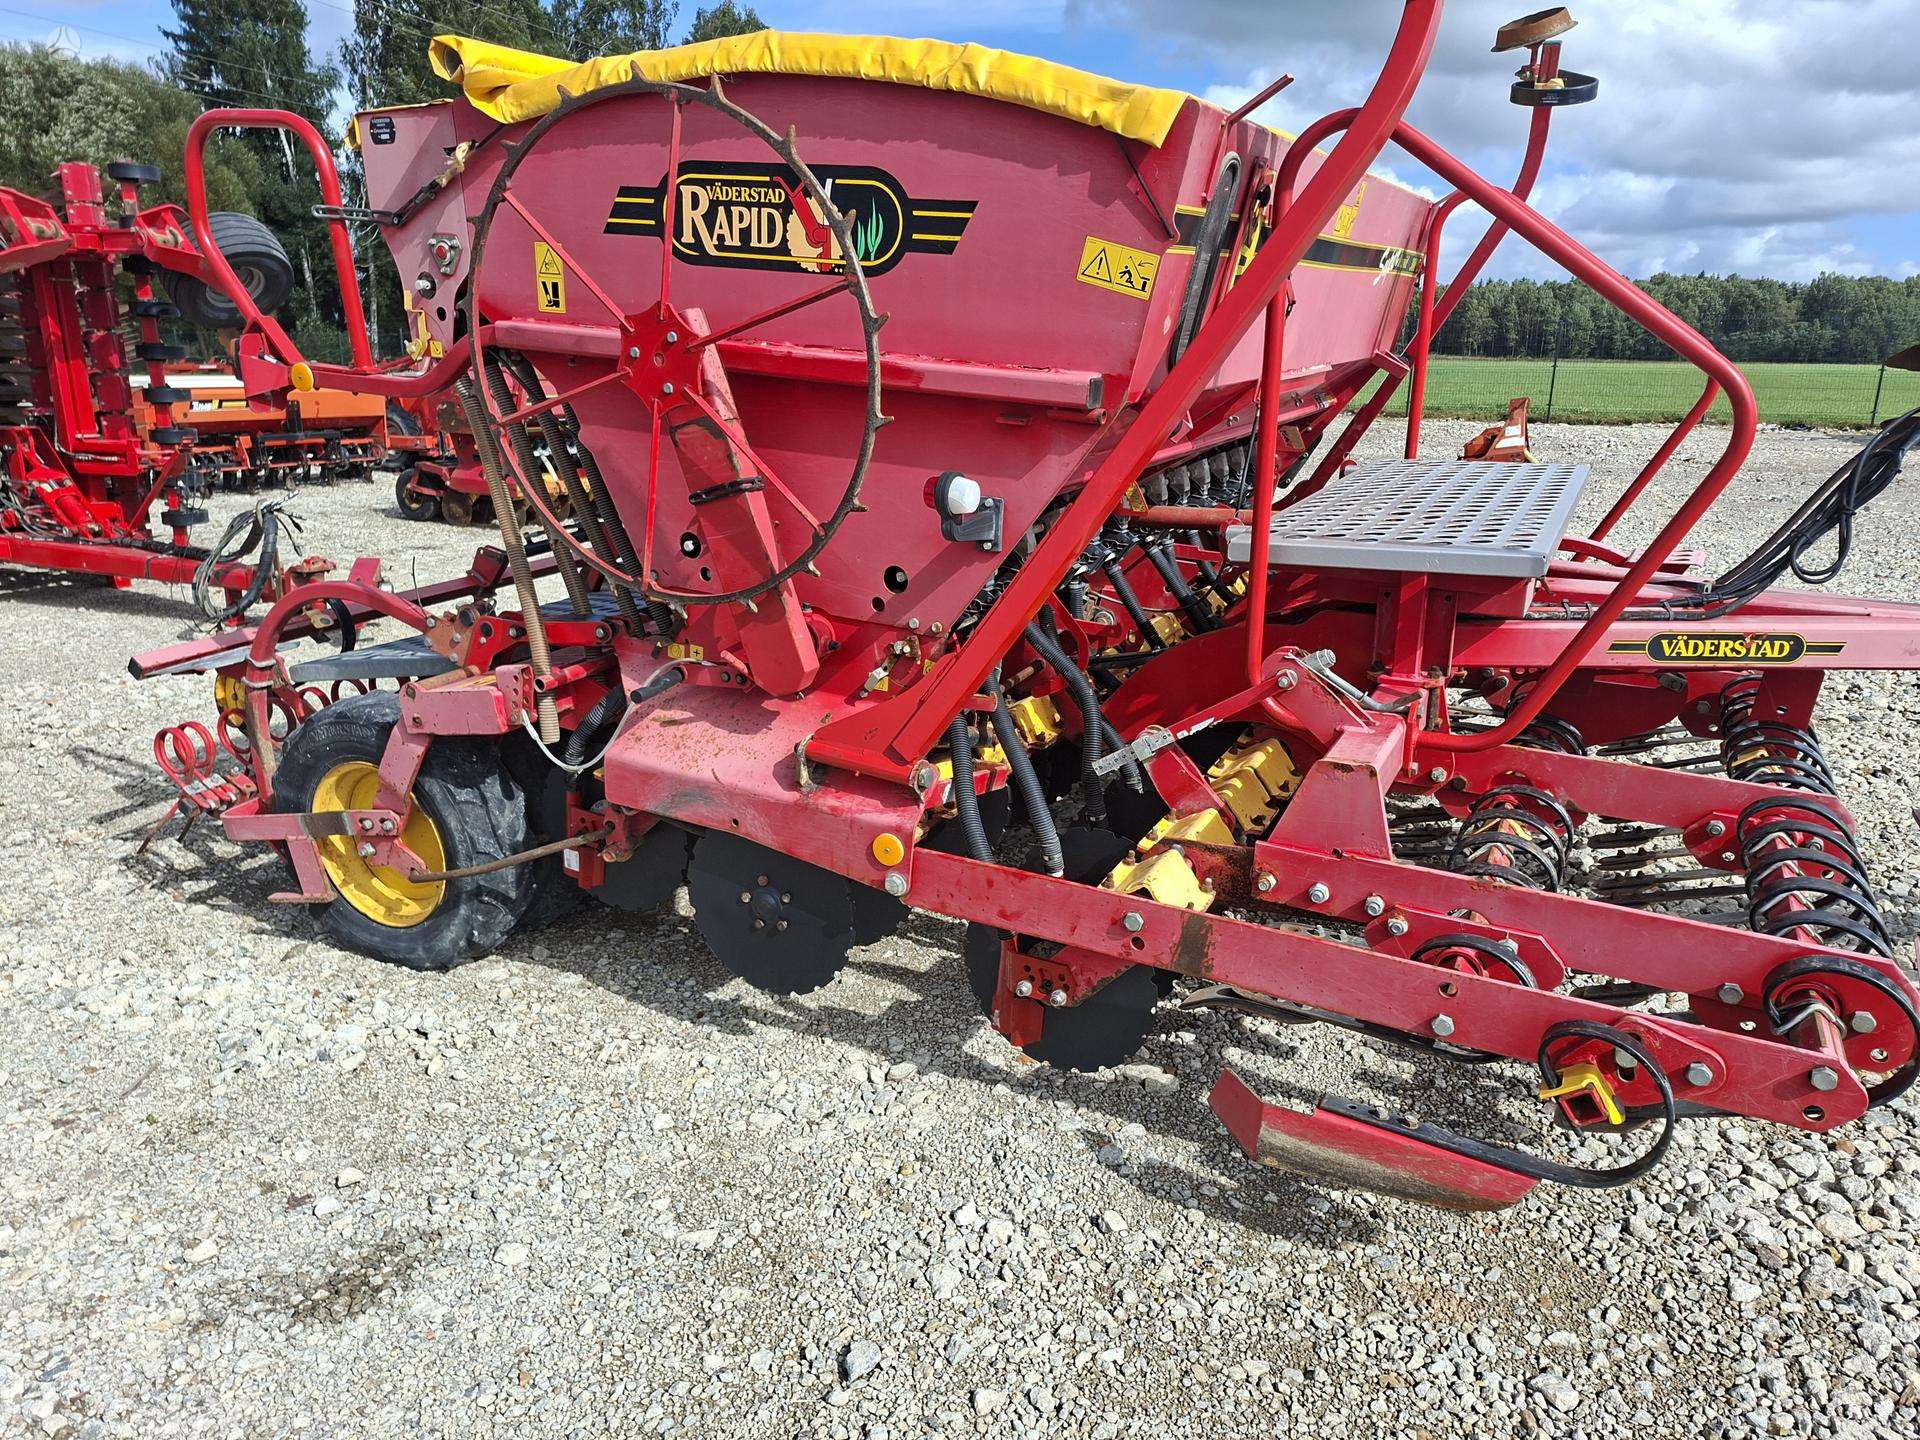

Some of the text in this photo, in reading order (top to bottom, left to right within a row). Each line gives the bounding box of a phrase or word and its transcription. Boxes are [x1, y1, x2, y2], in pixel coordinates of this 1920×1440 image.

[706, 182, 785, 202] VÄDERSTAD
[680, 185, 784, 256] RAPID
[1661, 635, 1791, 658] VÄDERSTAD
